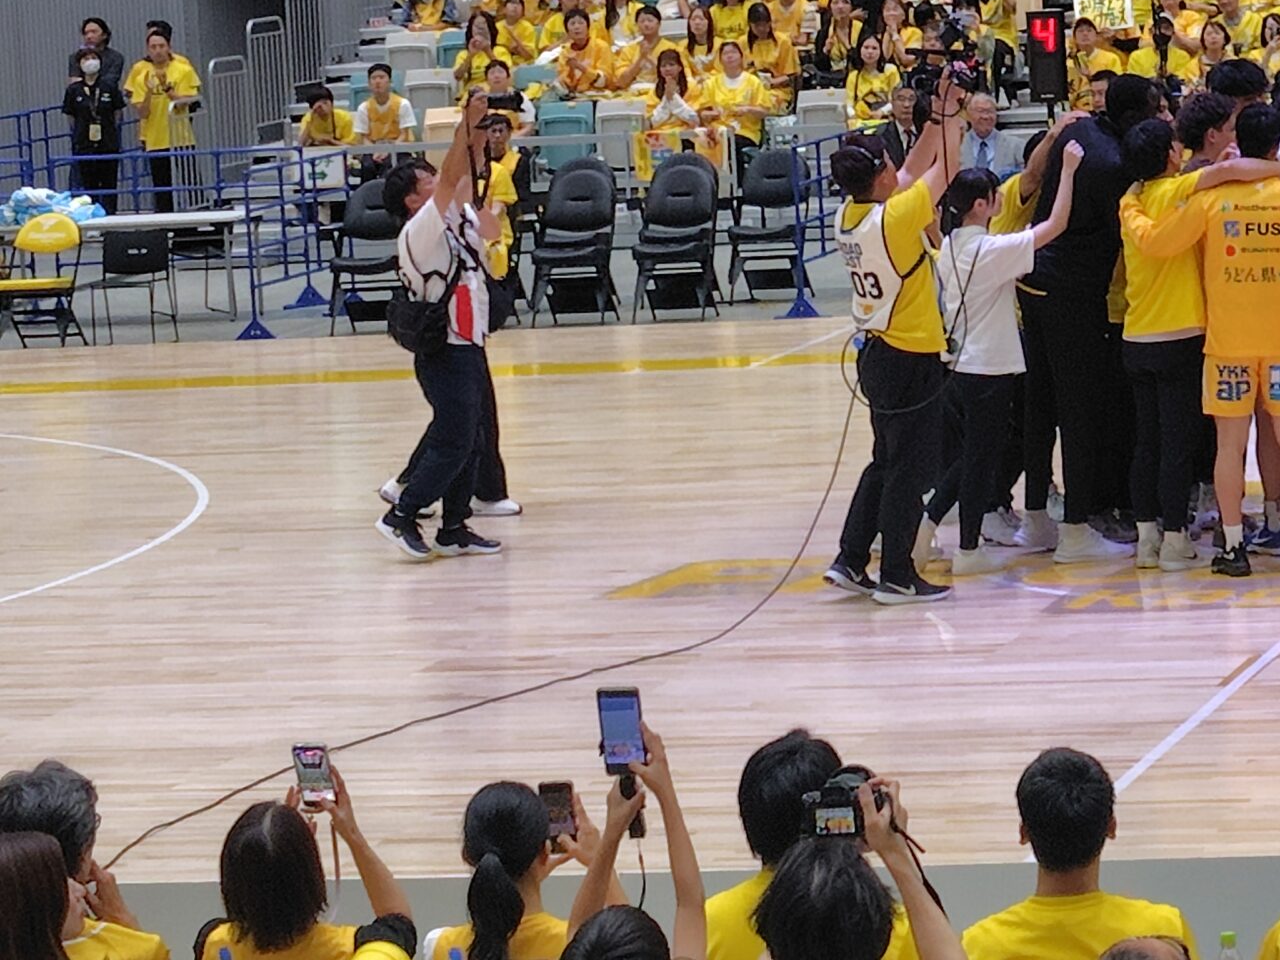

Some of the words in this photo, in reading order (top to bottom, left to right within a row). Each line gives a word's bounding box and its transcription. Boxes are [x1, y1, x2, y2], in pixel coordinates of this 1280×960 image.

[1031, 18, 1056, 53] 4
[1224, 266, 1277, 283] うどん県
[1216, 364, 1250, 378] YKK
